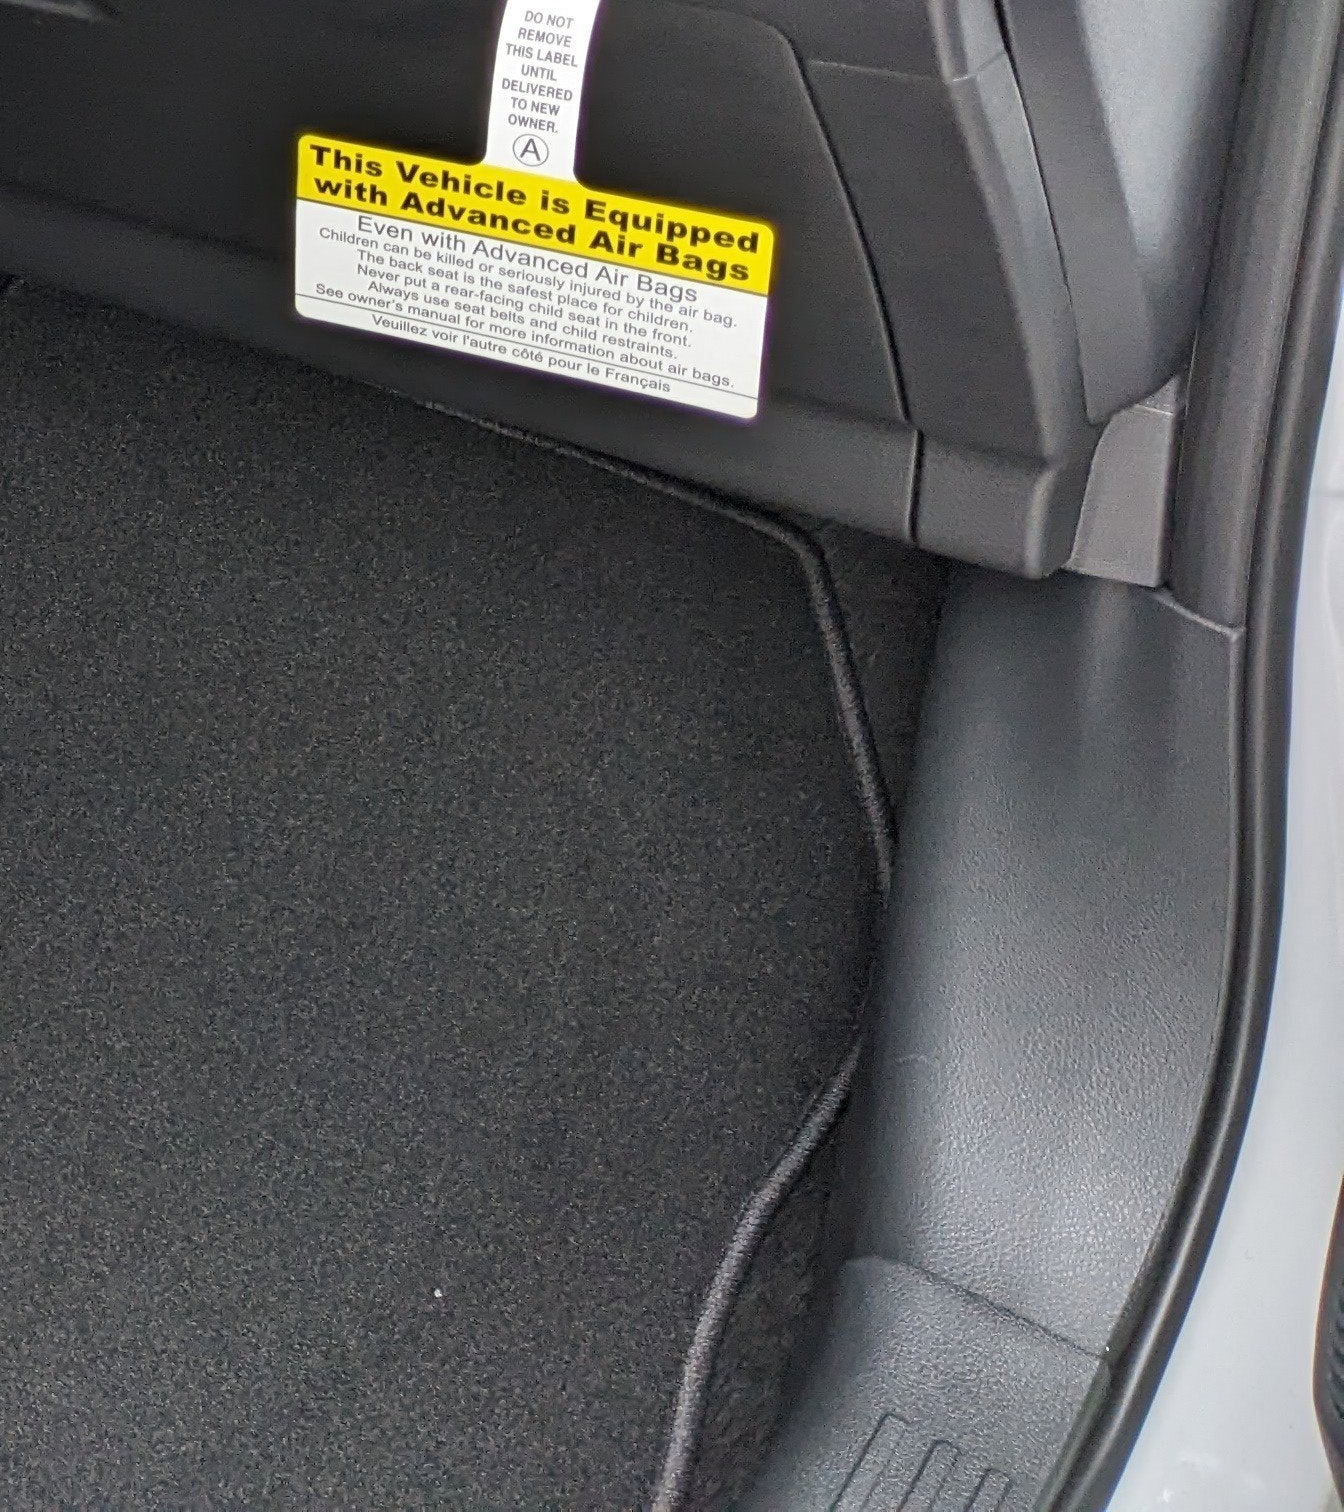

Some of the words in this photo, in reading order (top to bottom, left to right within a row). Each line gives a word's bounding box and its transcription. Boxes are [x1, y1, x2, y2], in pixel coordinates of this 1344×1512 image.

[506, 43, 533, 58] THIS
[537, 49, 578, 67] LABEL
[518, 27, 572, 48] REMOVE
[524, 10, 543, 24] DO
[546, 13, 574, 29] NOT
[502, 78, 572, 101] DELIVERED
[511, 96, 527, 110] TO
[530, 100, 560, 116] NEW
[521, 64, 557, 81] UNTIL
[508, 114, 558, 133] OWNER.
[310, 145, 383, 177] This
[396, 161, 527, 205] Vehicle
[541, 190, 570, 214] is
[585, 199, 759, 253] Equipped
[314, 177, 388, 206] with
[401, 191, 576, 245] Advanced
[589, 230, 643, 258] Air
[656, 243, 749, 282] Bags
[319, 227, 378, 249] Children
[384, 242, 409, 256] can
[414, 247, 432, 261] be
[436, 251, 473, 270] killed
[479, 262, 494, 273] or
[499, 266, 564, 290] seriously
[570, 280, 621, 301] injured
[627, 293, 645, 308] by
[649, 296, 674, 312] the
[679, 302, 699, 318] air
[703, 309, 737, 328] bag.
[357, 249, 384, 265] The
[390, 257, 423, 273] back
[428, 266, 458, 281] seat
[464, 272, 475, 284] is
[480, 276, 503, 291] the
[508, 282, 553, 302] safest
[558, 294, 598, 311] place
[603, 303, 623, 317] for
[627, 310, 693, 332] children.
[358, 215, 413, 242] Even
[422, 232, 466, 252] with
[473, 240, 588, 278] Advanced
[595, 266, 629, 286] Air
[637, 274, 698, 302] Bags
[315, 283, 343, 299] See
[348, 289, 403, 312] owner's
[408, 305, 461, 325] manual
[465, 316, 484, 330] for
[489, 322, 526, 339] more
[531, 332, 615, 360] information
[620, 352, 662, 370] about
[668, 362, 687, 376] air
[692, 367, 735, 387] bags.
[357, 265, 400, 283] Never
[404, 276, 427, 291] put
[431, 282, 440, 291] a
[445, 283, 524, 311] rear-facing
[529, 301, 563, 318] child
[568, 311, 600, 326] seat
[605, 315, 619, 330] in
[623, 320, 647, 337] the
[652, 328, 692, 348] front.
[368, 281, 419, 303] Always
[423, 294, 449, 308] use
[455, 299, 485, 316] seat
[490, 307, 525, 325] belts
[530, 318, 557, 332] and
[563, 323, 597, 341] child
[602, 334, 678, 359] restraints.
[372, 314, 427, 337] Veuillez
[432, 328, 458, 344] voir
[463, 335, 507, 355] l'autre
[512, 347, 543, 363] côté
[549, 357, 583, 373] pour
[587, 362, 600, 376] le
[605, 367, 671, 392] Français
